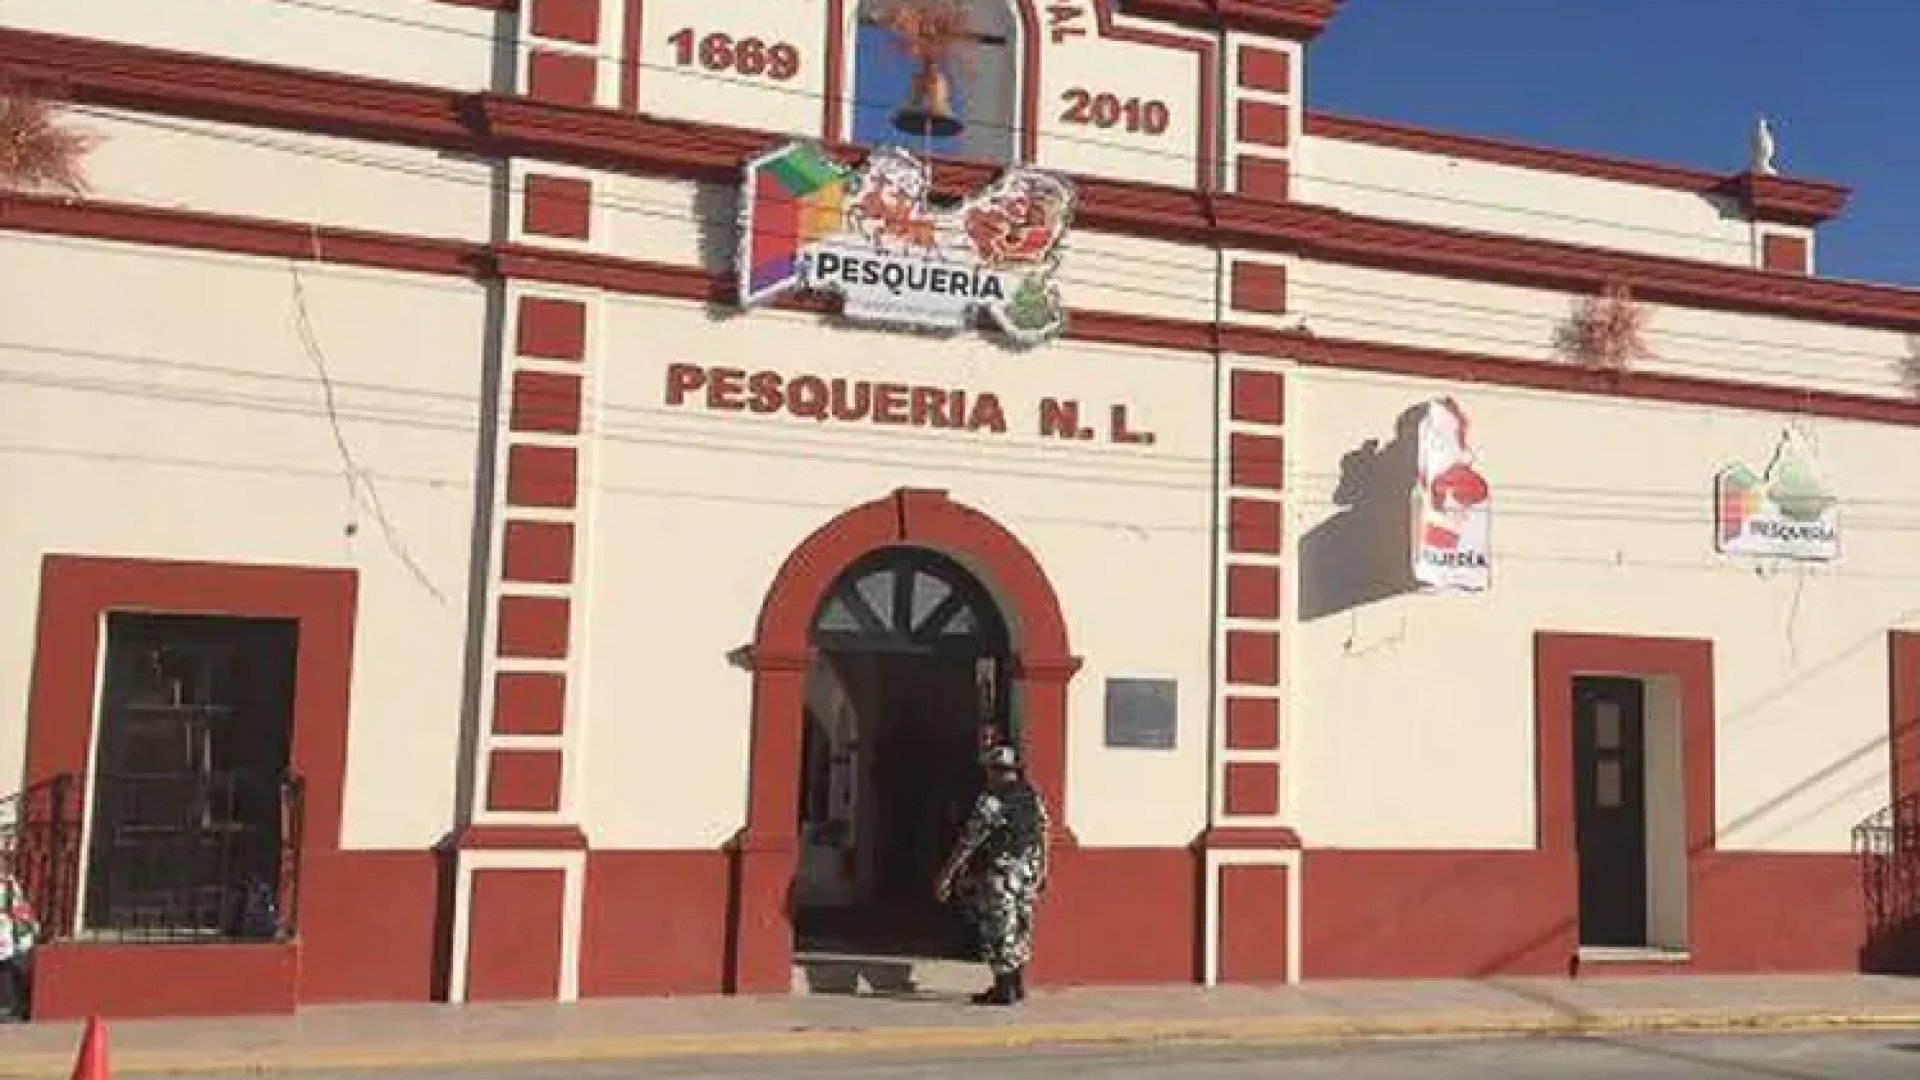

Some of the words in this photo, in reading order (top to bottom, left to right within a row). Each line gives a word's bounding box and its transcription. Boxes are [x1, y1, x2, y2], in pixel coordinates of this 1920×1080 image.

[667, 28, 799, 80] 1669
[1060, 88, 1170, 136] 2010
[665, 362, 1007, 433] PESQUERIA
[1039, 397, 1095, 440] N.
[1110, 403, 1156, 444] L.
